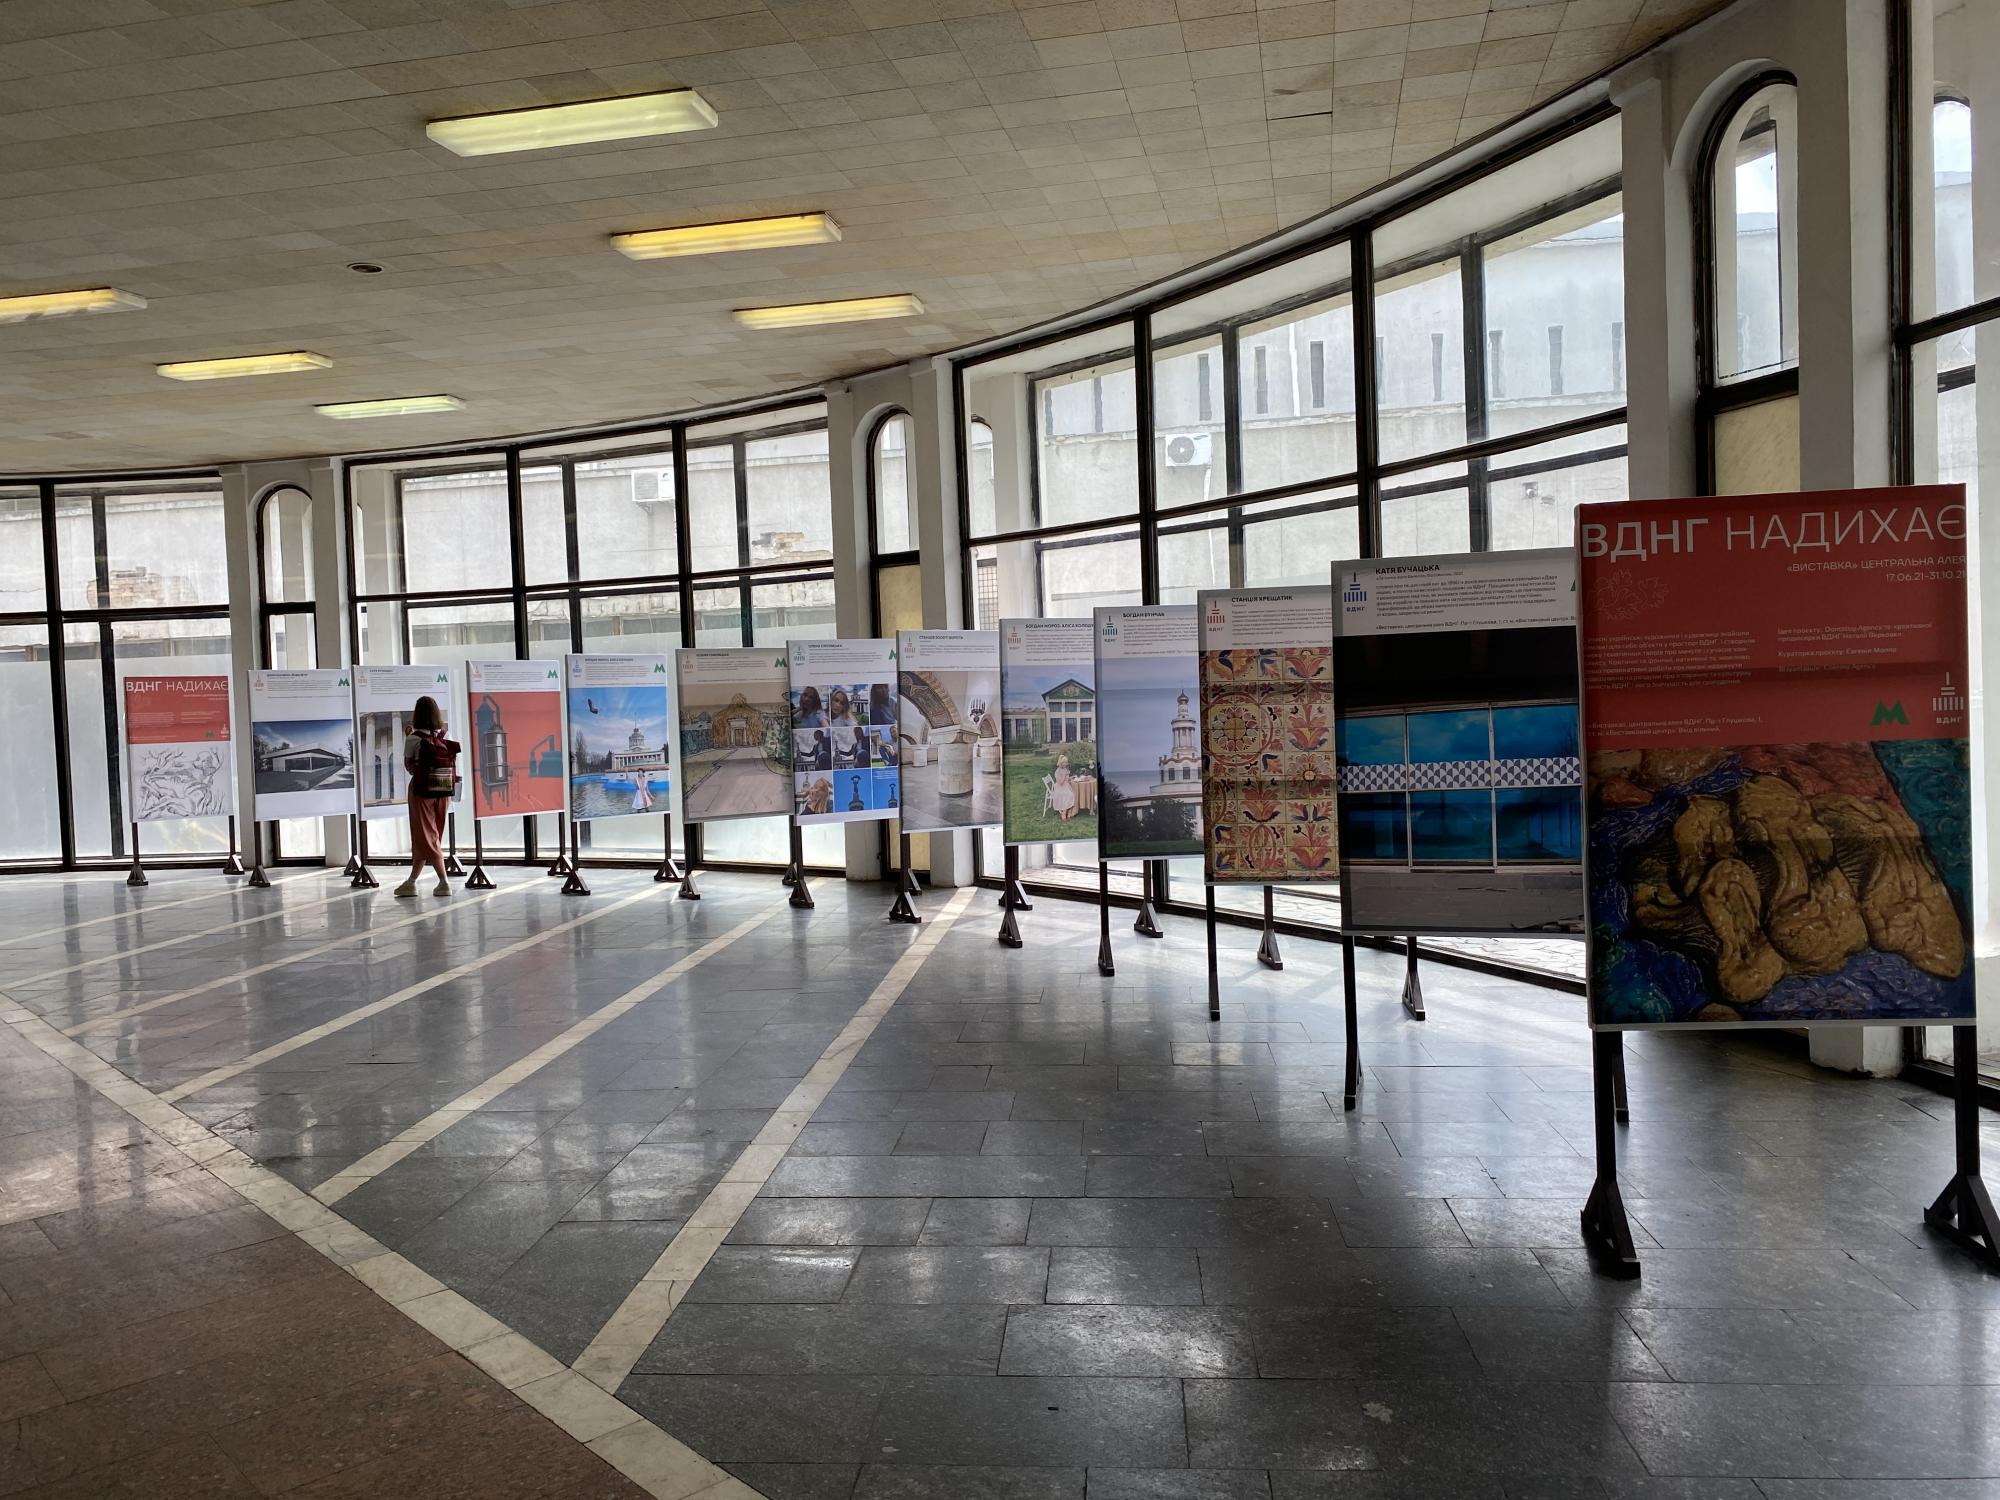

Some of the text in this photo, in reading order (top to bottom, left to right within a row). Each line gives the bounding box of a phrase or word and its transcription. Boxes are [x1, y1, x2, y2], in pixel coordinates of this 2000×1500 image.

[1582, 504, 1967, 564] ВДНГ НАДИХАЄ
[1375, 564, 1440, 575] КАТЯ БУЧАЦЬКА
[1786, 555, 1967, 573] «ВИСТАВКА» ЦЕНТРАЛЬНА АЛЕЯ
[126, 679, 229, 694] ВДНГ НАДИХАЄ
[1936, 716, 1963, 725] ВДНГ
